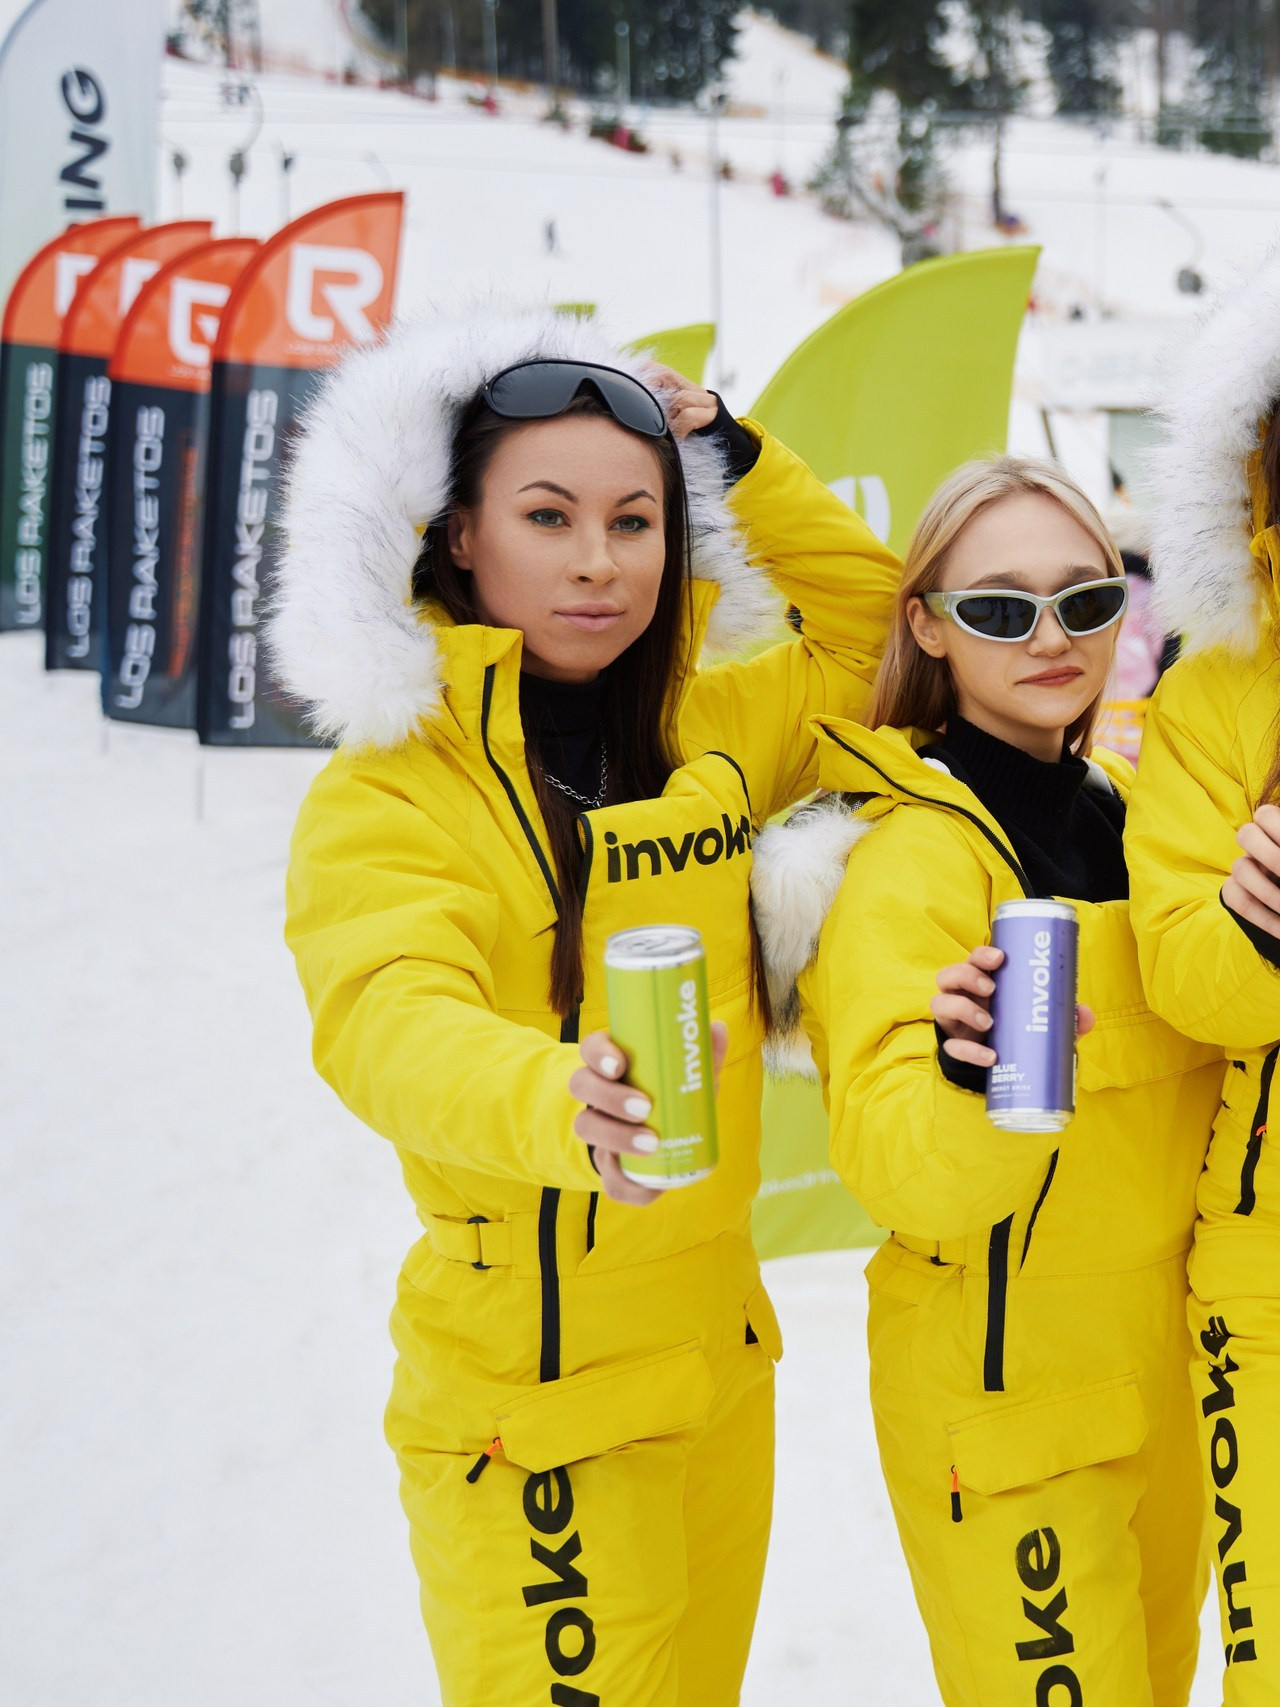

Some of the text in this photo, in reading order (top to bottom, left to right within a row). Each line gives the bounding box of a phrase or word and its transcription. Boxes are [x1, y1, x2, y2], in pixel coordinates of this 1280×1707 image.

[61, 69, 109, 212] ING
[15, 361, 54, 625] LOS RAKETOS
[66, 375, 111, 658] LOS RAKETOS
[114, 405, 166, 710] LOS RAKETOS
[228, 390, 279, 729] LOS RAKETOS
[677, 978, 702, 1095] invoke
[1025, 930, 1051, 1033] invoke
[992, 1063, 1018, 1075] BLUE
[992, 1072, 1026, 1084] BERRY
